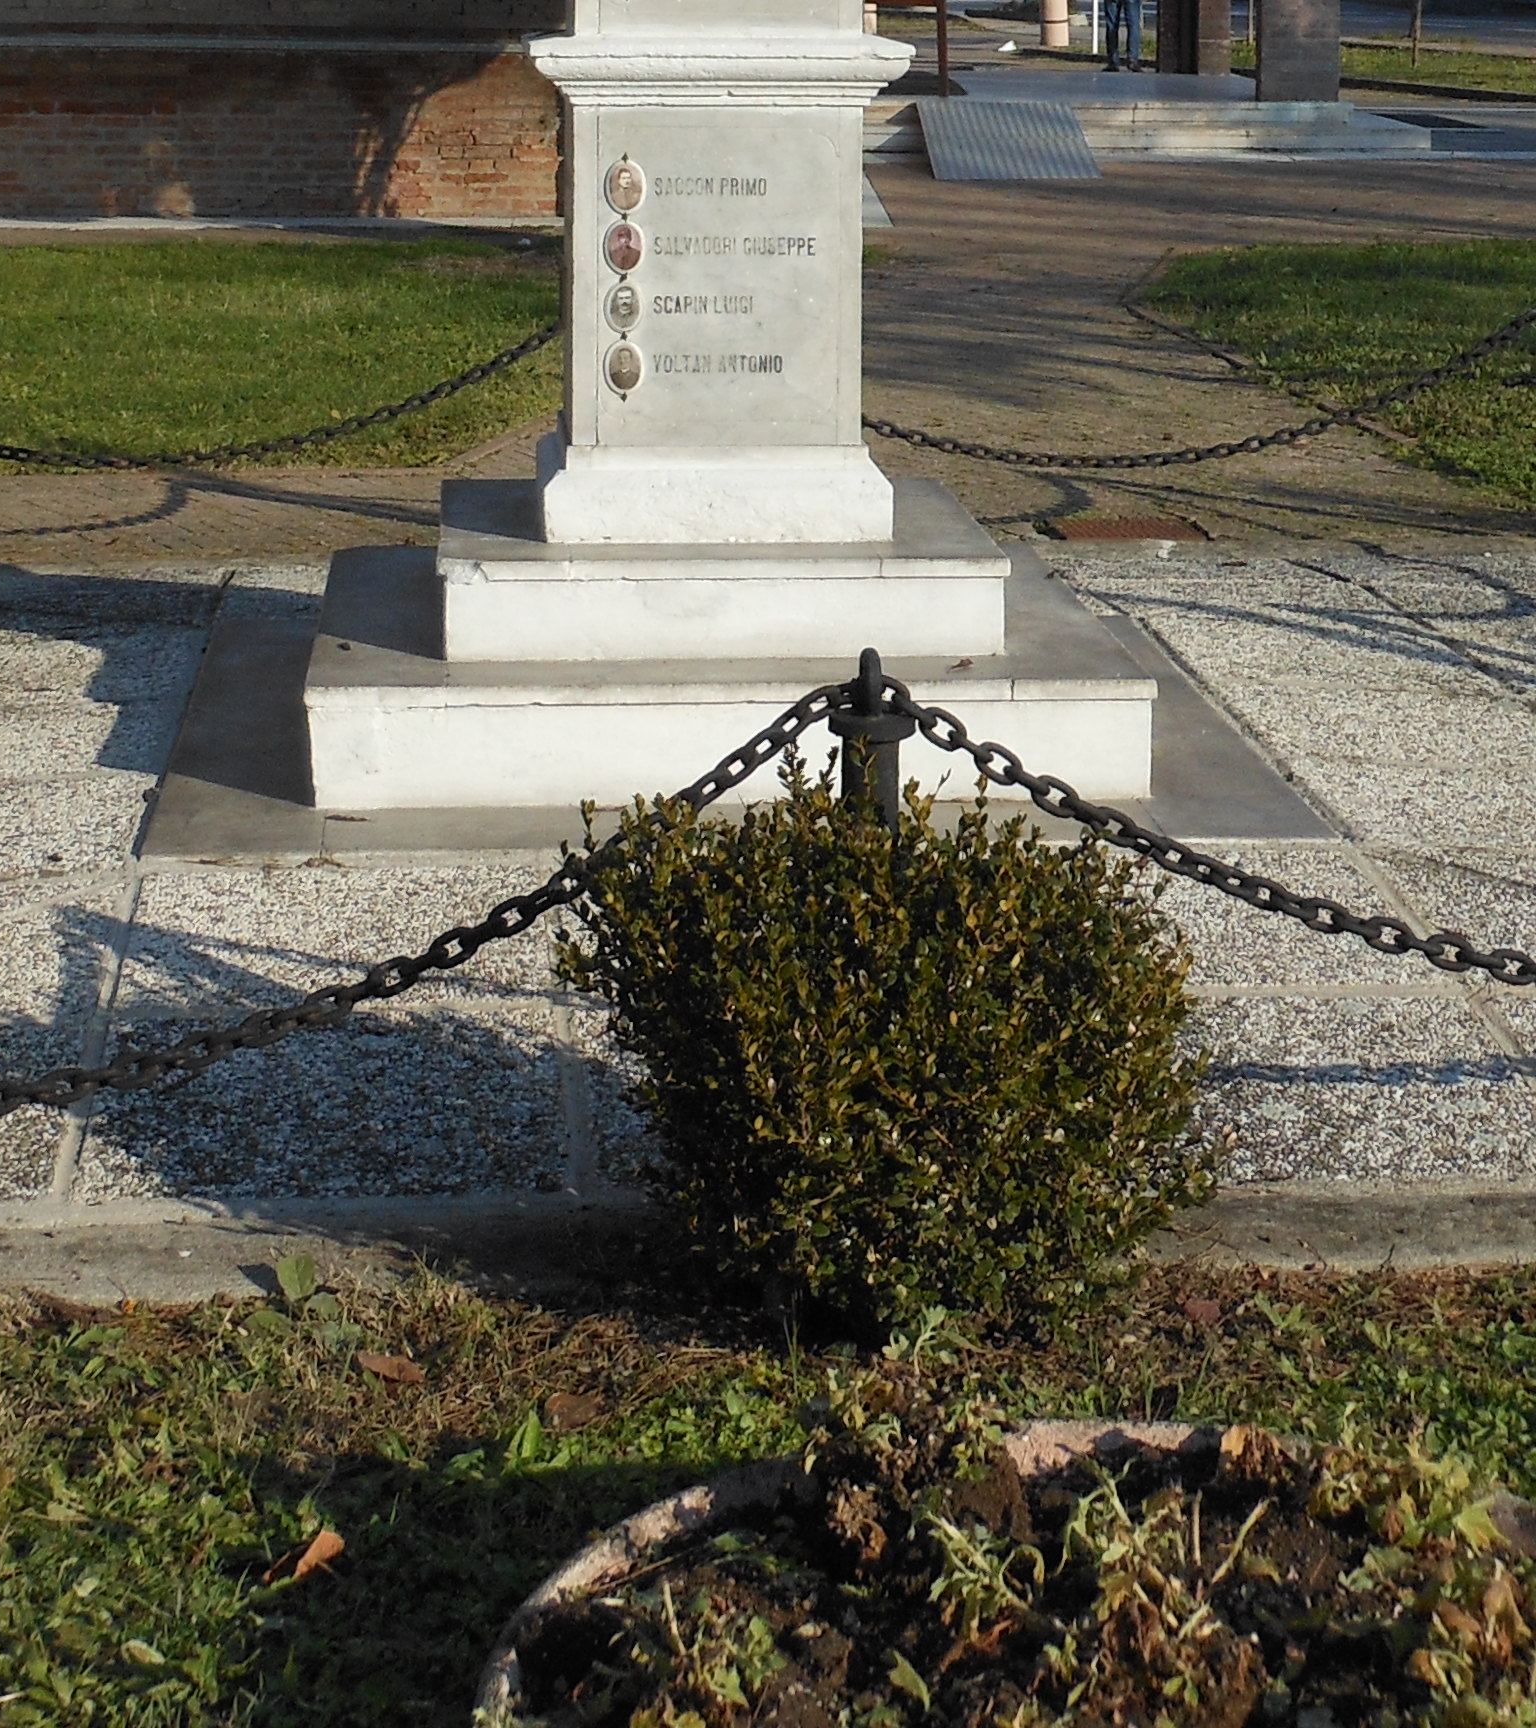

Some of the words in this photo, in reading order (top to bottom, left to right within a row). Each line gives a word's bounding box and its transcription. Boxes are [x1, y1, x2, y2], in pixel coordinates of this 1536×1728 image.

[654, 177, 714, 196] SACCON
[720, 177, 767, 196] PRIMO
[653, 236, 737, 256] SALVADORI
[743, 237, 817, 257] GIUSEPPE
[653, 295, 708, 315] SCAPIN
[714, 295, 754, 315] LUIGI
[652, 354, 711, 373] VOLTAN
[718, 354, 784, 374] ANTONIO
